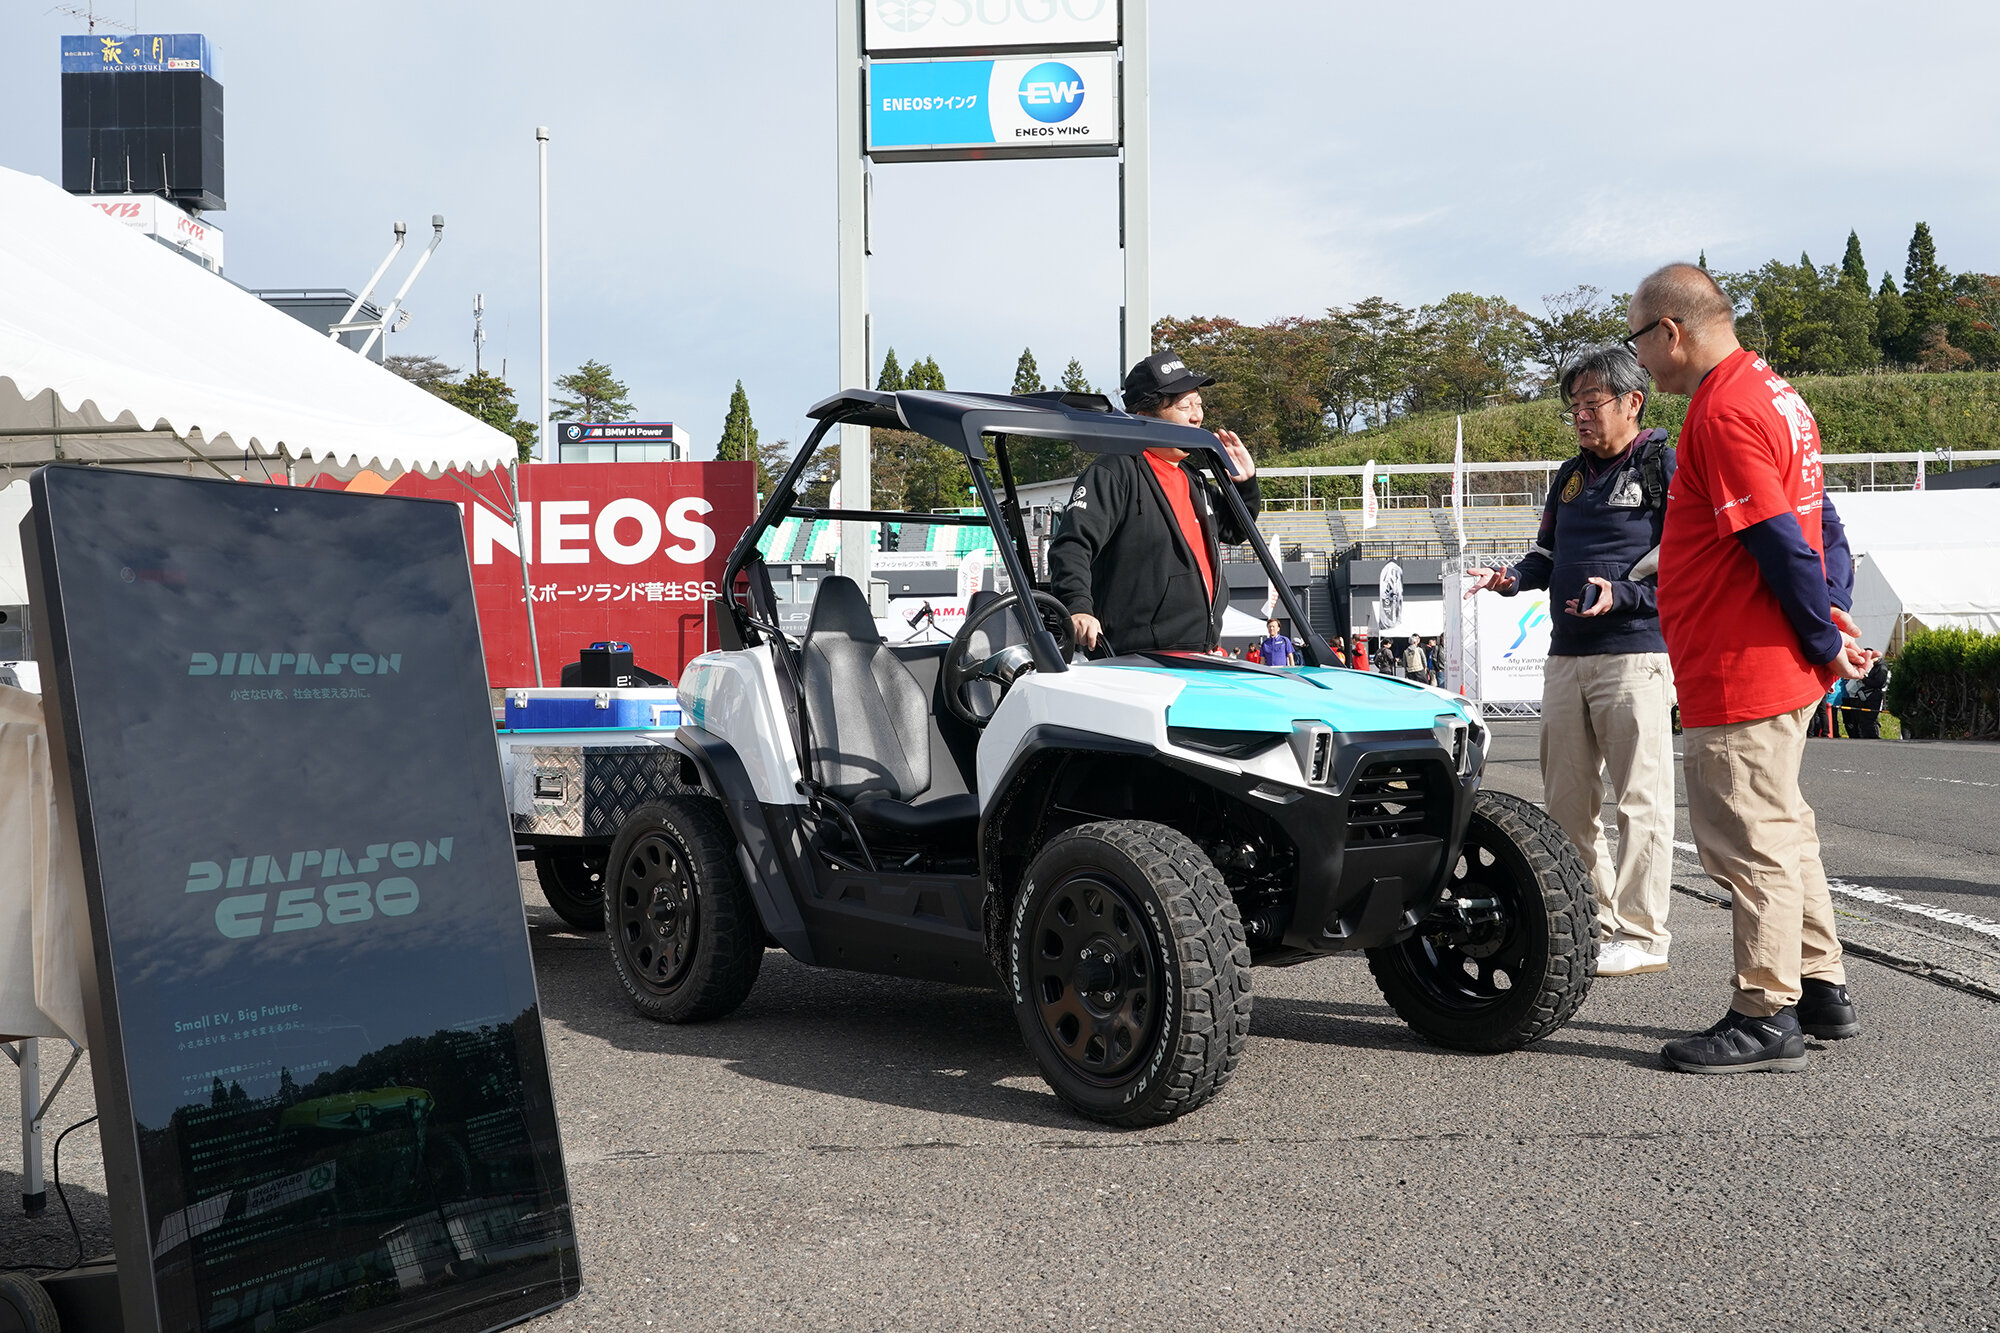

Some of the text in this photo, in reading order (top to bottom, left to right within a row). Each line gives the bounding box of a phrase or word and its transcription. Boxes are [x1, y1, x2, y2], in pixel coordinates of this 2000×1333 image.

[883, 94, 977, 111] ENEOSウイング
[1015, 126, 1090, 137] ENEOS WING
[91, 203, 142, 217] YB
[605, 428, 626, 436] BMW
[628, 428, 636, 436] M
[637, 428, 663, 436] Power
[454, 497, 716, 565] NEOS
[521, 581, 717, 602] スポーツランド菅生SS
[188, 652, 402, 675] DIAPASON
[185, 836, 454, 895] DIAPASON
[214, 876, 420, 939] C580
[1011, 879, 1036, 1005] TOYO TIRES
[1144, 900, 1169, 965] OPEN
[174, 1002, 303, 1033] Small EV, Big Future.
[1149, 969, 1173, 1078] COUNTRY
